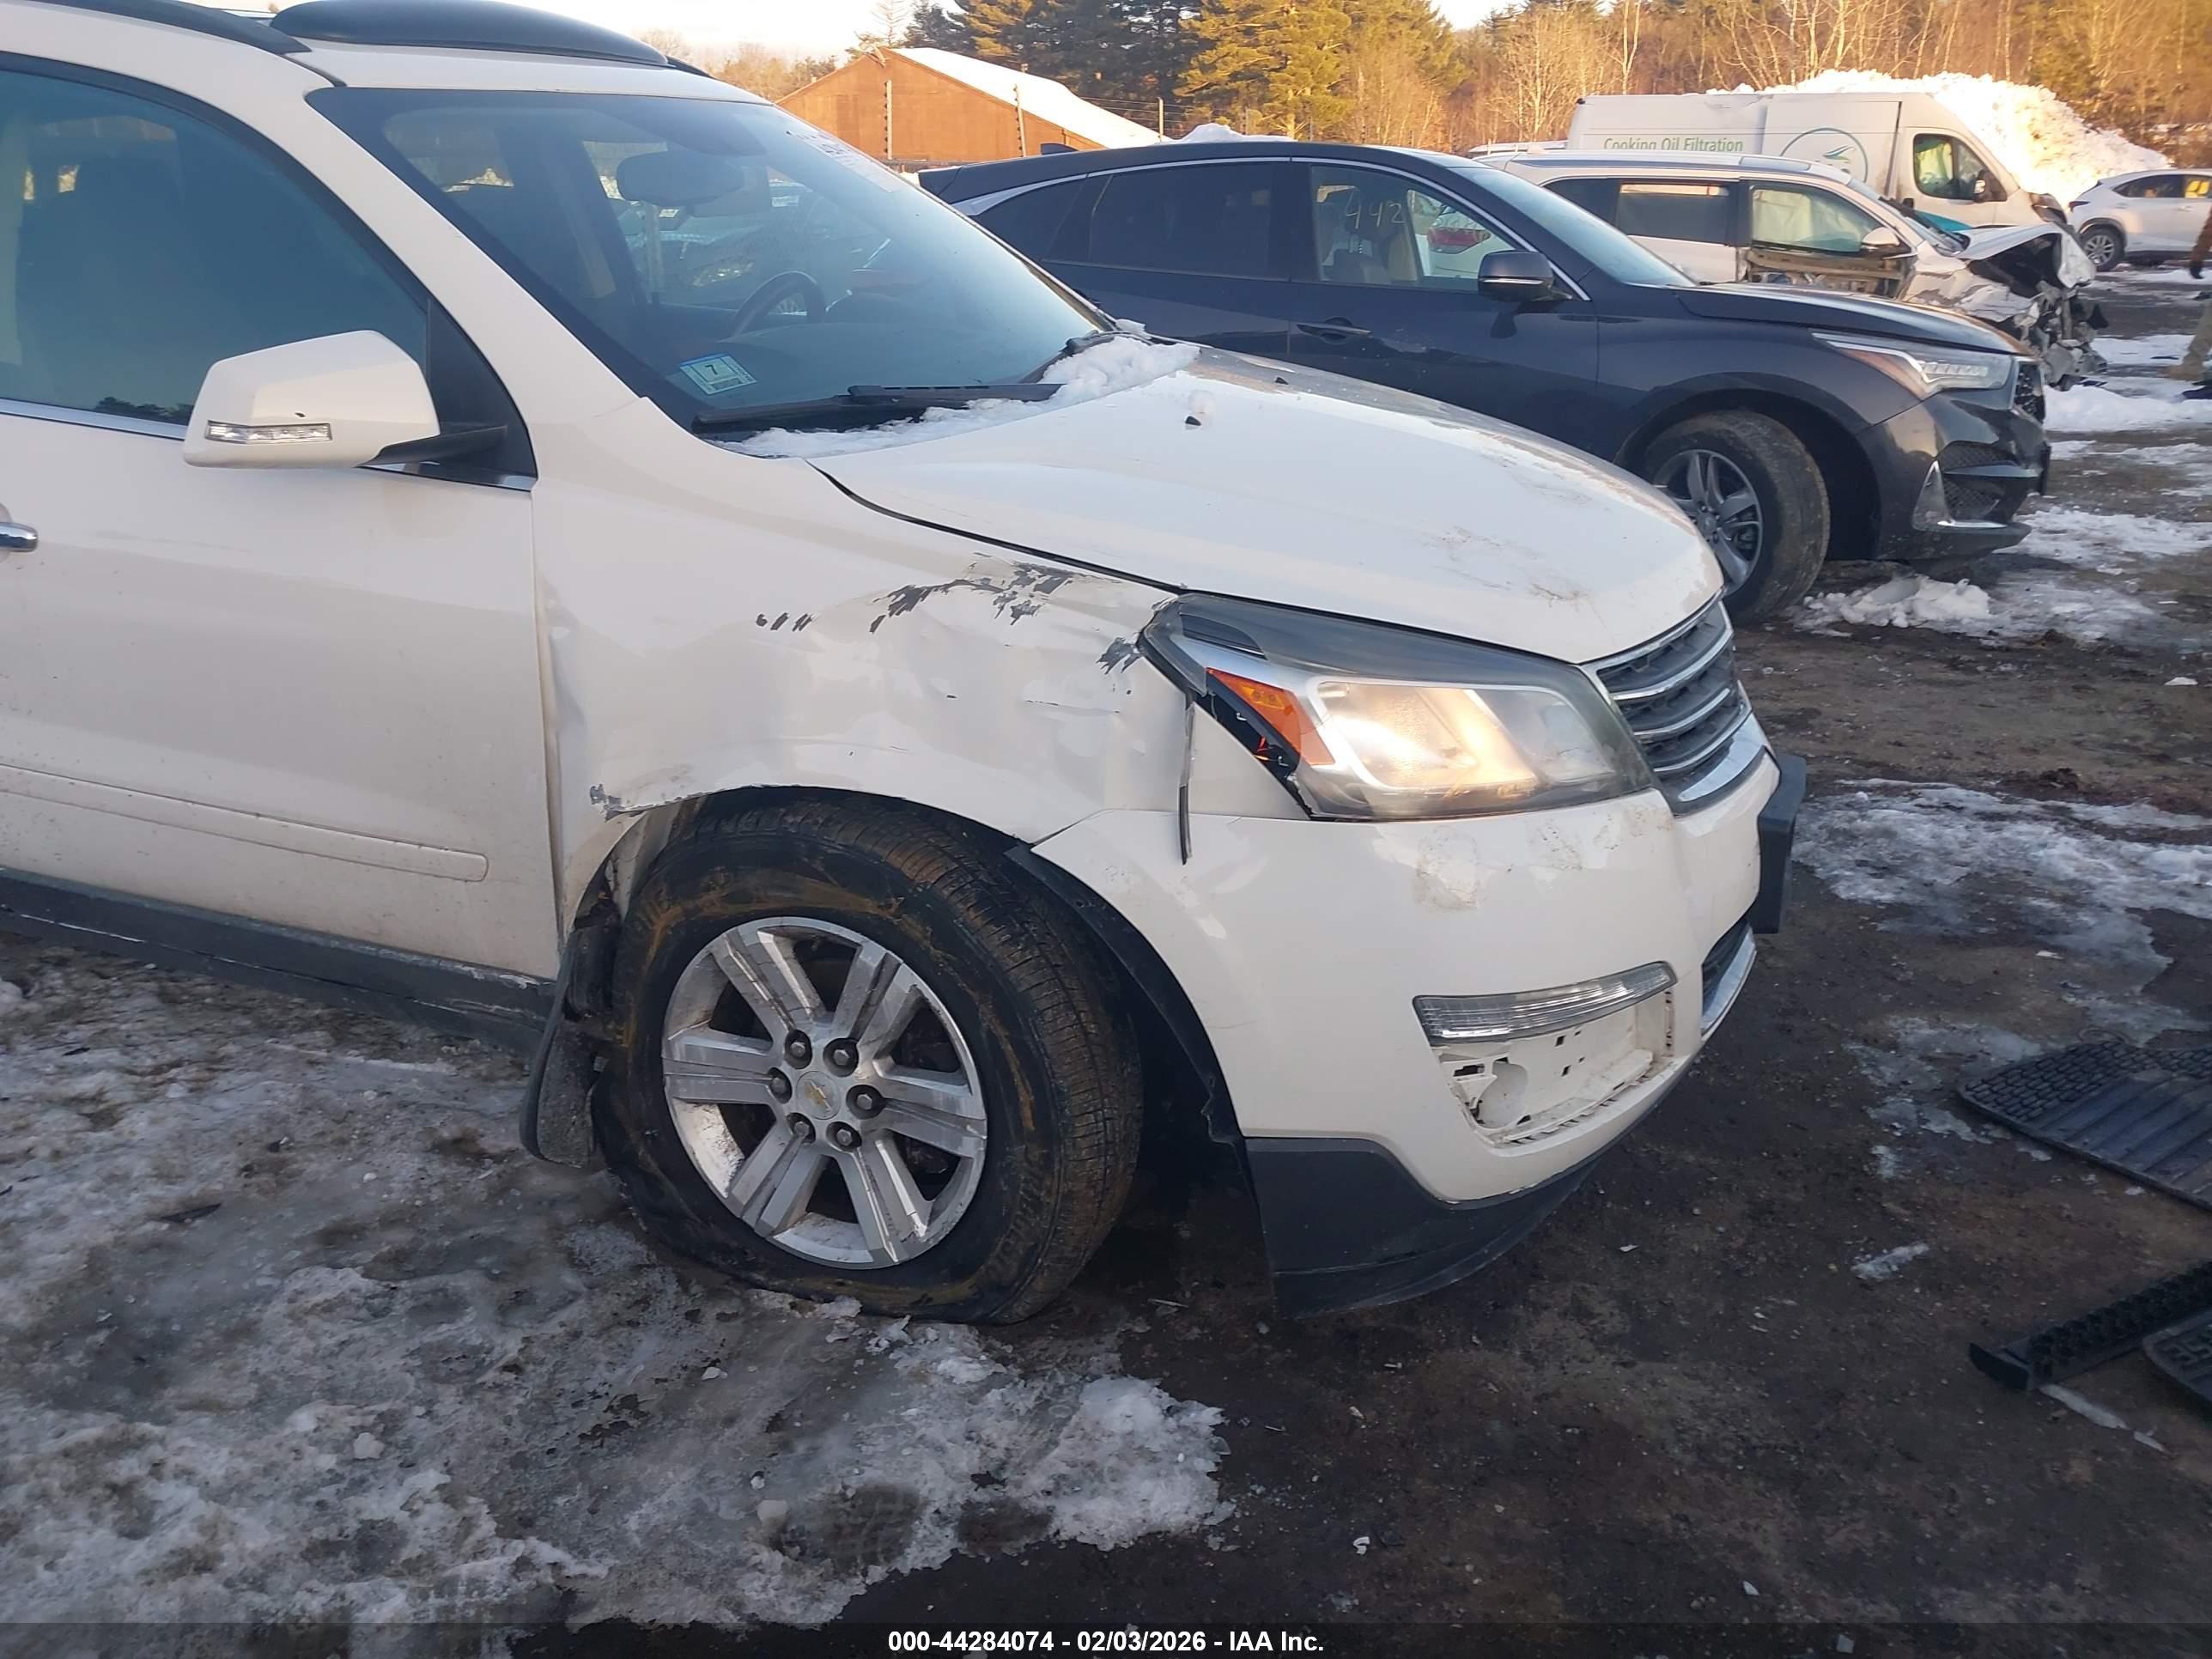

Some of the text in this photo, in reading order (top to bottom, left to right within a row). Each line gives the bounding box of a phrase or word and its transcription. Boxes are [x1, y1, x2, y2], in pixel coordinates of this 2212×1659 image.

[1604, 137, 1743, 152] Cooking Oil Filtration
[705, 364, 718, 375] 7
